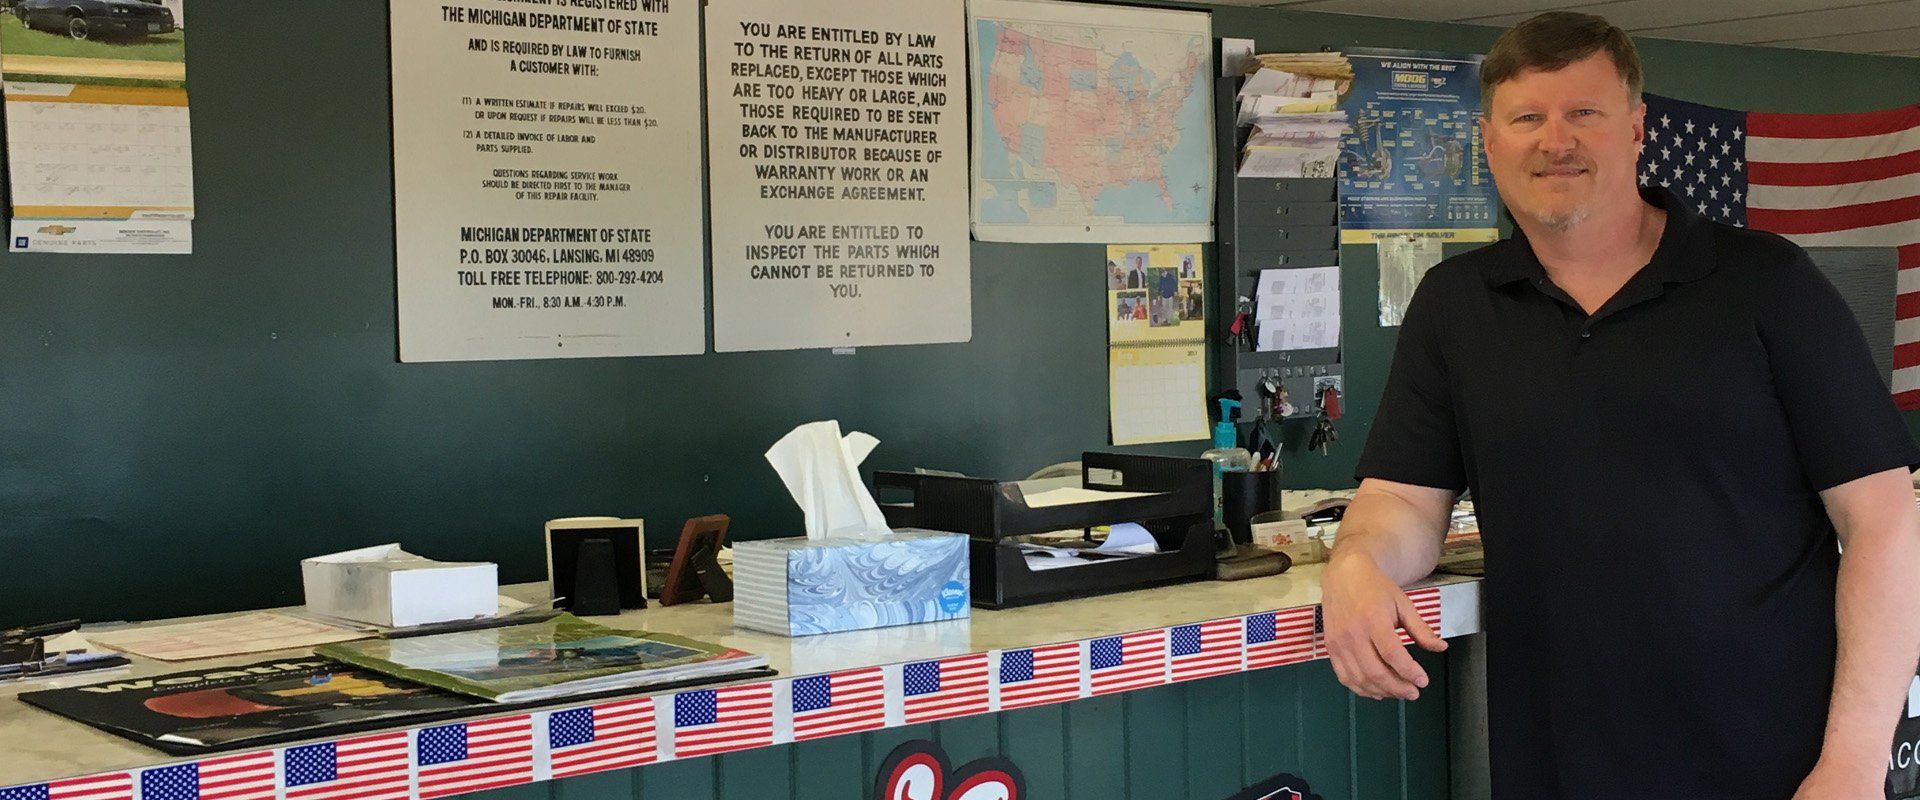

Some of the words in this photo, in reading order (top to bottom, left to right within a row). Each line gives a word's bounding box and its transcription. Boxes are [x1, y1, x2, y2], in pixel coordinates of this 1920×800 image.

[641, 0, 669, 13] WITH
[442, 6, 464, 24] THE
[468, 8, 526, 28] MICHIGAN
[529, 12, 605, 33] DEPARTMENT
[607, 17, 622, 34] OF
[624, 19, 658, 37] STATE
[740, 22, 770, 39] YOU
[777, 24, 806, 41] ARE
[812, 26, 879, 45] ENTITLED
[885, 31, 903, 47] BY
[908, 32, 936, 49] LAW
[468, 37, 487, 52] AND
[491, 39, 500, 53] IS
[503, 39, 549, 56] REQUIRED
[552, 43, 564, 57] BY
[567, 44, 587, 58] LAW
[590, 45, 601, 59] TO
[604, 46, 640, 62] FURNISH
[734, 43, 754, 58] TO
[760, 44, 787, 60] THE
[794, 46, 850, 64] RETURN
[854, 50, 871, 65] OF
[878, 51, 903, 67] ALL
[907, 53, 943, 69] PARTS
[510, 59, 516, 72] A
[519, 60, 569, 75] CUSTOMER
[731, 63, 803, 81] REPLACED,
[806, 67, 857, 84] EXCEPT
[861, 70, 903, 86] THOSE
[908, 72, 946, 88] WHICH
[1394, 73, 1426, 84] MOOG
[733, 83, 761, 99] ARE
[767, 84, 794, 101] TOO
[802, 86, 844, 103] HEAVY
[850, 88, 867, 104] OR
[873, 89, 920, 106] LARGE,
[922, 91, 946, 107] AND
[476, 98, 481, 106] A
[484, 98, 513, 107] WRITTEN
[516, 100, 547, 109] ESTIMATE
[548, 101, 555, 109] IF
[558, 102, 585, 111] REPAIRS
[588, 103, 603, 112] WILL
[606, 104, 628, 113] EXCEED
[475, 111, 484, 119] OR
[487, 112, 507, 121] UPON
[509, 113, 538, 122] REQUEST
[540, 114, 546, 122] IF
[549, 114, 576, 124] REPAIRS
[578, 115, 594, 125] WILL
[596, 116, 606, 125] BE
[607, 117, 621, 126] LESS
[624, 117, 641, 127] THAN
[740, 104, 784, 120] THOSE
[792, 106, 860, 123] REQUIRED
[866, 108, 883, 123] TO
[887, 109, 903, 124] BE
[908, 110, 941, 125] SENT
[476, 132, 480, 140] A
[484, 132, 514, 141] DETAILED
[518, 133, 542, 142] INVOICE
[547, 134, 554, 142] OF
[558, 135, 578, 143] LABOR
[582, 135, 595, 144] AND
[742, 125, 776, 140] BACK
[781, 126, 798, 140] TO
[804, 127, 828, 141] THE
[833, 127, 937, 144] MANUFACTURER
[476, 144, 498, 154] PARTS
[740, 144, 757, 159] OR
[764, 145, 856, 162] DISTRIBUTOR
[864, 148, 921, 163] BECAUSE
[927, 150, 942, 164] OF
[493, 169, 529, 179] QUESTIONS
[531, 170, 568, 180] REGARDING
[571, 171, 597, 181] SERVICE
[598, 172, 618, 182] WORK
[755, 165, 836, 181] WARRANTY
[841, 166, 881, 181] WORK
[887, 168, 904, 182] OR
[910, 168, 929, 182] AN
[482, 180, 508, 190] SHOULD
[511, 181, 519, 190] BE
[522, 181, 552, 190] DIRECTED
[554, 181, 571, 191] FIRST
[574, 182, 582, 191] TO
[585, 182, 596, 191] THE
[599, 182, 630, 192] MANAGER
[761, 186, 834, 201] EXCHANGE
[841, 187, 926, 201] AGREEMENT.
[516, 191, 524, 201] OF
[527, 191, 541, 201] THIS
[544, 191, 568, 202] REPAIR
[461, 227, 519, 243] MICHIGAN
[522, 227, 598, 244] DEPARTMENT
[600, 228, 614, 244] OF
[617, 228, 651, 244] STATE
[765, 225, 793, 240] YOU
[798, 225, 825, 240] ARE
[833, 225, 899, 240] ENTITLED
[907, 225, 923, 240] TO
[460, 250, 482, 264] P.O.
[486, 250, 508, 264] BOX
[511, 250, 550, 264] 30046,
[553, 249, 602, 264] LANSING,
[606, 249, 619, 263] MI
[622, 249, 654, 263] 48909
[746, 245, 806, 260] INSPECT
[813, 245, 840, 260] THE
[848, 245, 889, 260] PARTS
[896, 245, 939, 260] WHICH
[458, 271, 486, 286] TOLL
[491, 271, 520, 286] FREE
[525, 271, 591, 285] TELEPHONE:
[597, 271, 663, 285] 800-292-4204
[751, 265, 811, 280] CANNOT
[817, 265, 833, 279] BE
[840, 264, 914, 279] RETURNED
[919, 264, 934, 278] TO
[830, 284, 862, 298] YOU.
[607, 296, 626, 308] P.M.
